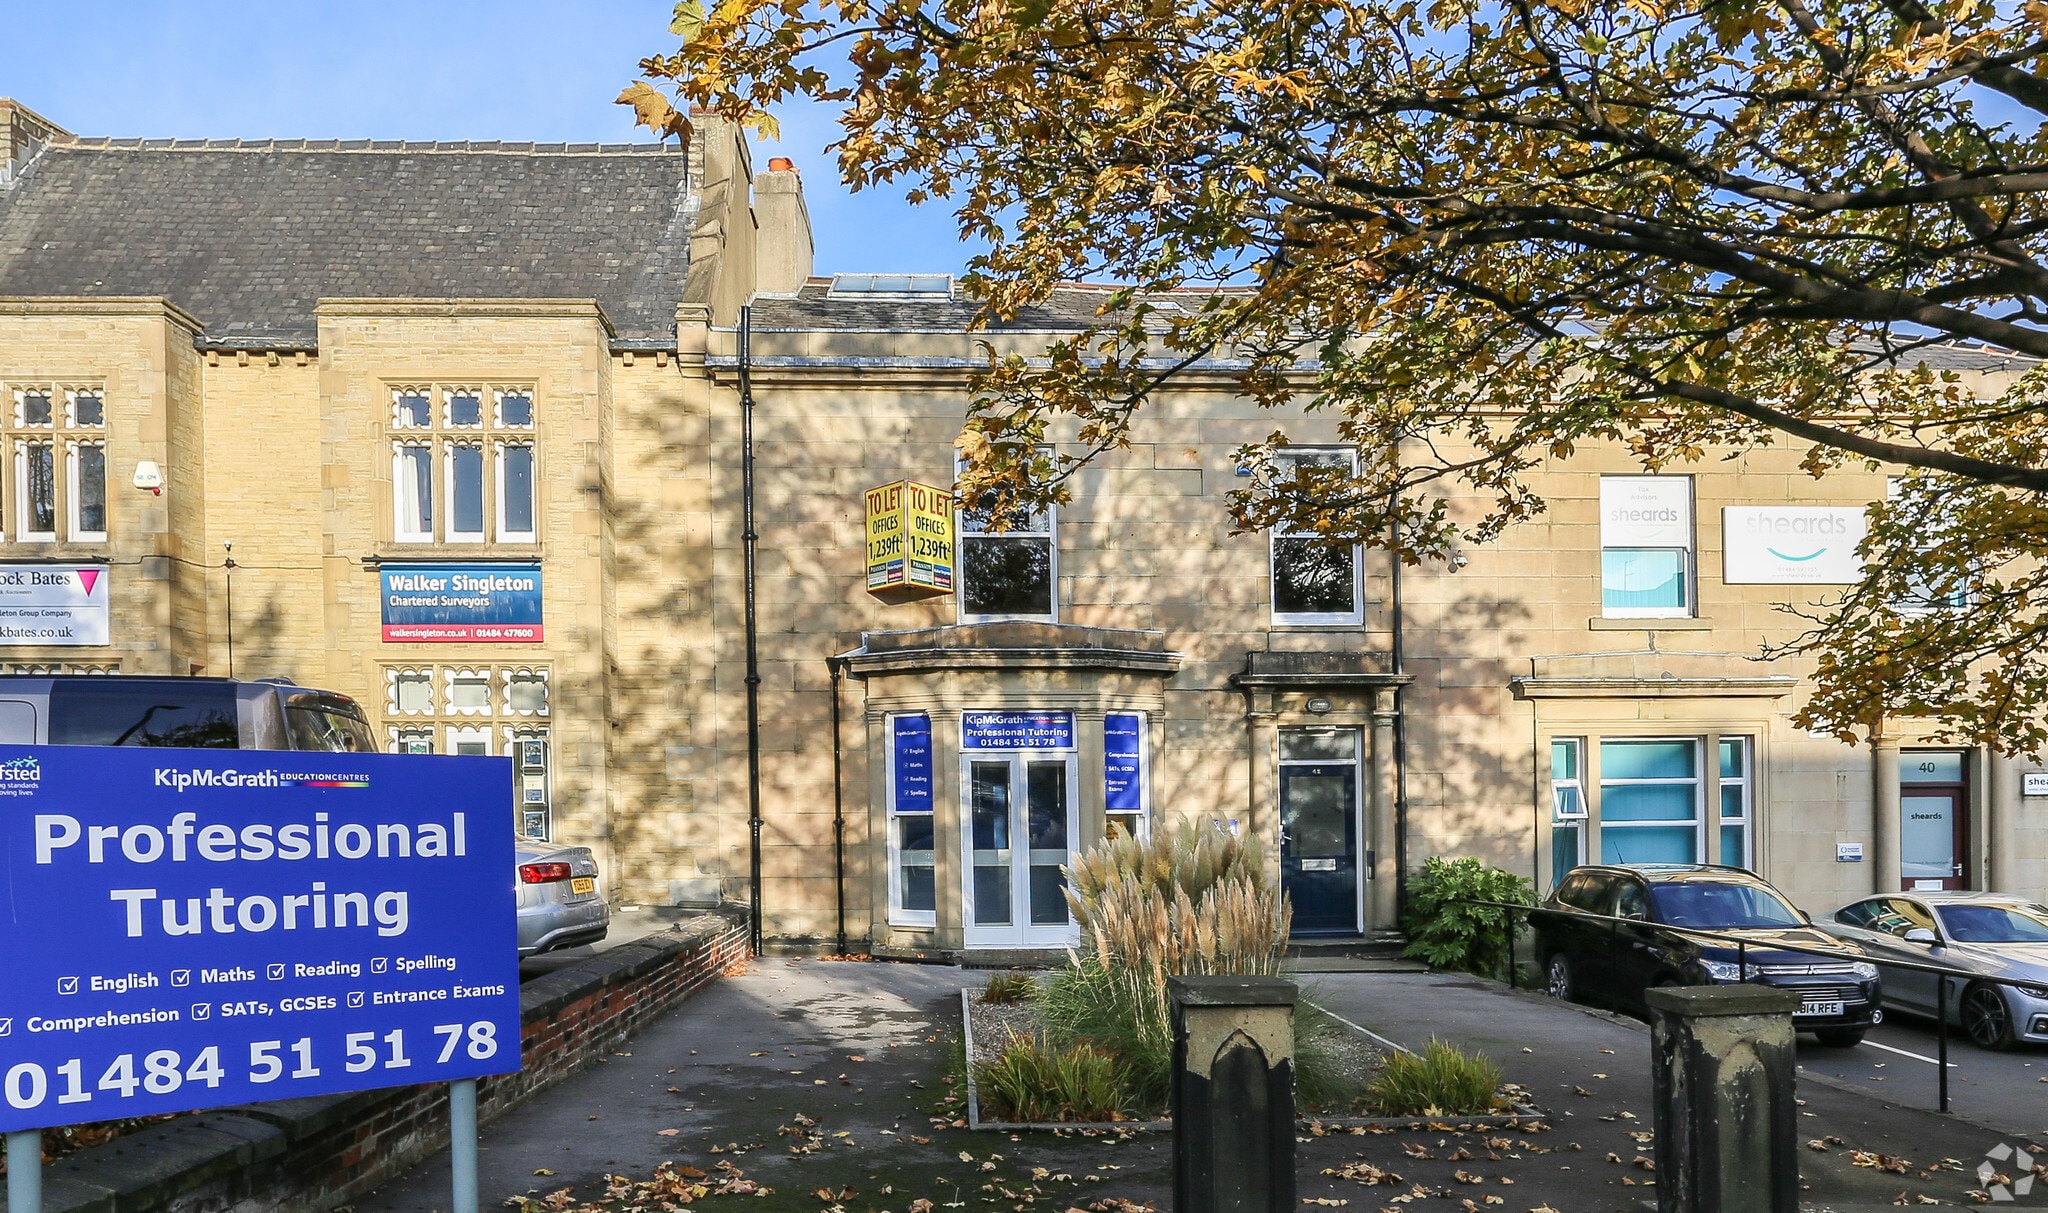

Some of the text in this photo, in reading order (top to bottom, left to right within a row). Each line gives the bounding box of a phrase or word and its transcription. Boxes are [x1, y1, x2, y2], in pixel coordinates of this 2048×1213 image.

[868, 486, 902, 516] TO LET
[911, 486, 950, 517] TO LET
[873, 514, 898, 534] OFFICES
[1611, 507, 1678, 522] sheards
[1746, 511, 1847, 534] sheards
[916, 516, 945, 535] OFFICES
[31, 572, 71, 585] Bates
[389, 574, 534, 595] Walker Singleton
[390, 596, 490, 608] Chartered Surveyors
[19, 609, 39, 618] Group
[41, 609, 72, 618] Company
[389, 629, 533, 639] walkersingleton.co.uk 01484 477600
[966, 715, 1023, 727] KipMcGrath
[967, 728, 1068, 737] Professional Tutoring
[980, 738, 1056, 746] 01484 51 51 78
[1919, 762, 1935, 773] 40
[155, 769, 277, 792] KipMcGrath
[1911, 812, 1942, 820] sheards
[35, 812, 466, 864] Professional
[110, 882, 409, 937] Tutoring
[90, 955, 456, 993] English Maths Reading Spelling
[27, 983, 505, 1033] Comprehension SATs, GCSEs Entrance Exams
[1818, 1003, 1837, 1013] RFE
[4, 1020, 498, 1109] 01484 51 51 78
